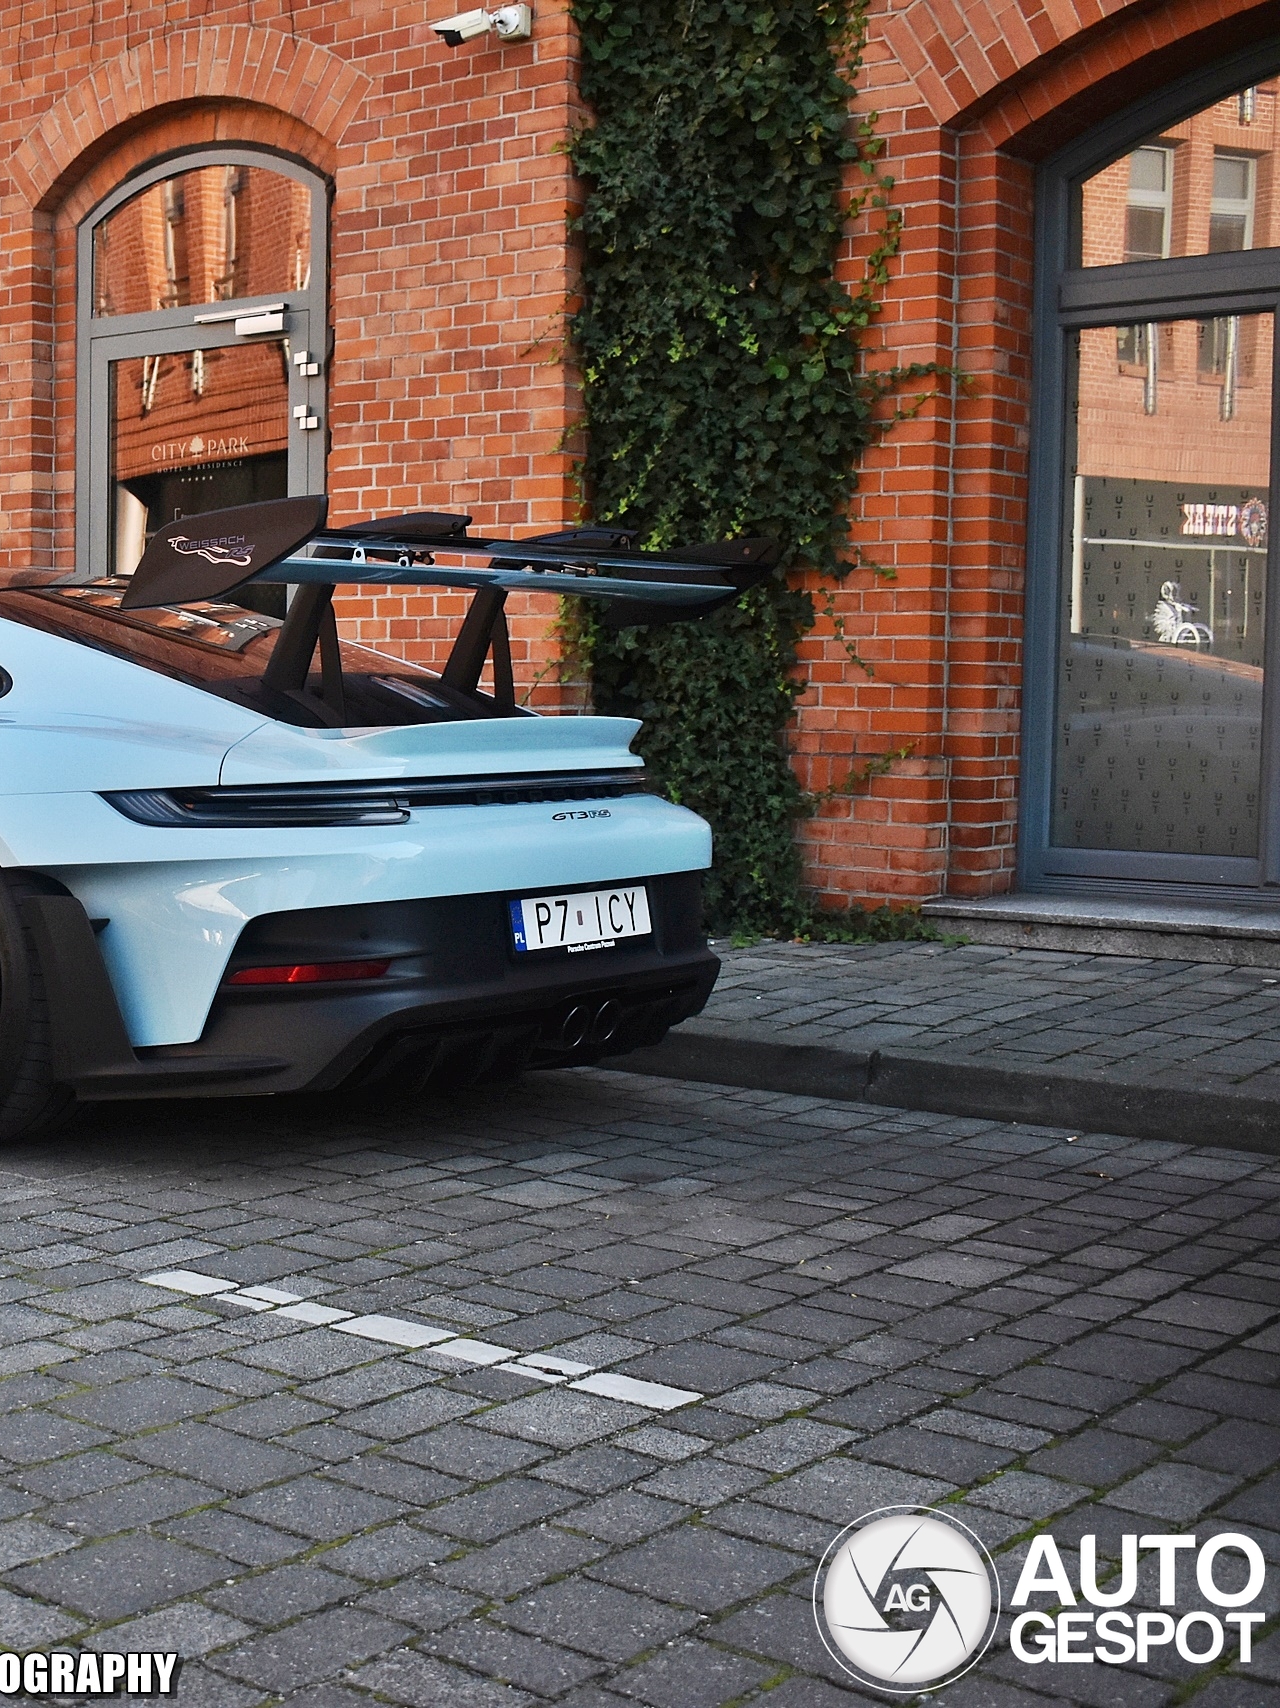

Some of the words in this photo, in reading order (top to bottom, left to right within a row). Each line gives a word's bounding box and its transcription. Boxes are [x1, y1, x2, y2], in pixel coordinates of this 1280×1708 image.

[151, 442, 187, 461] CITY
[207, 436, 249, 456] PARK
[196, 460, 243, 470] RESIDENCE
[178, 534, 246, 550] WEISSACH
[535, 899, 569, 945] P7
[595, 891, 636, 936] ICY
[514, 931, 525, 945] PL
